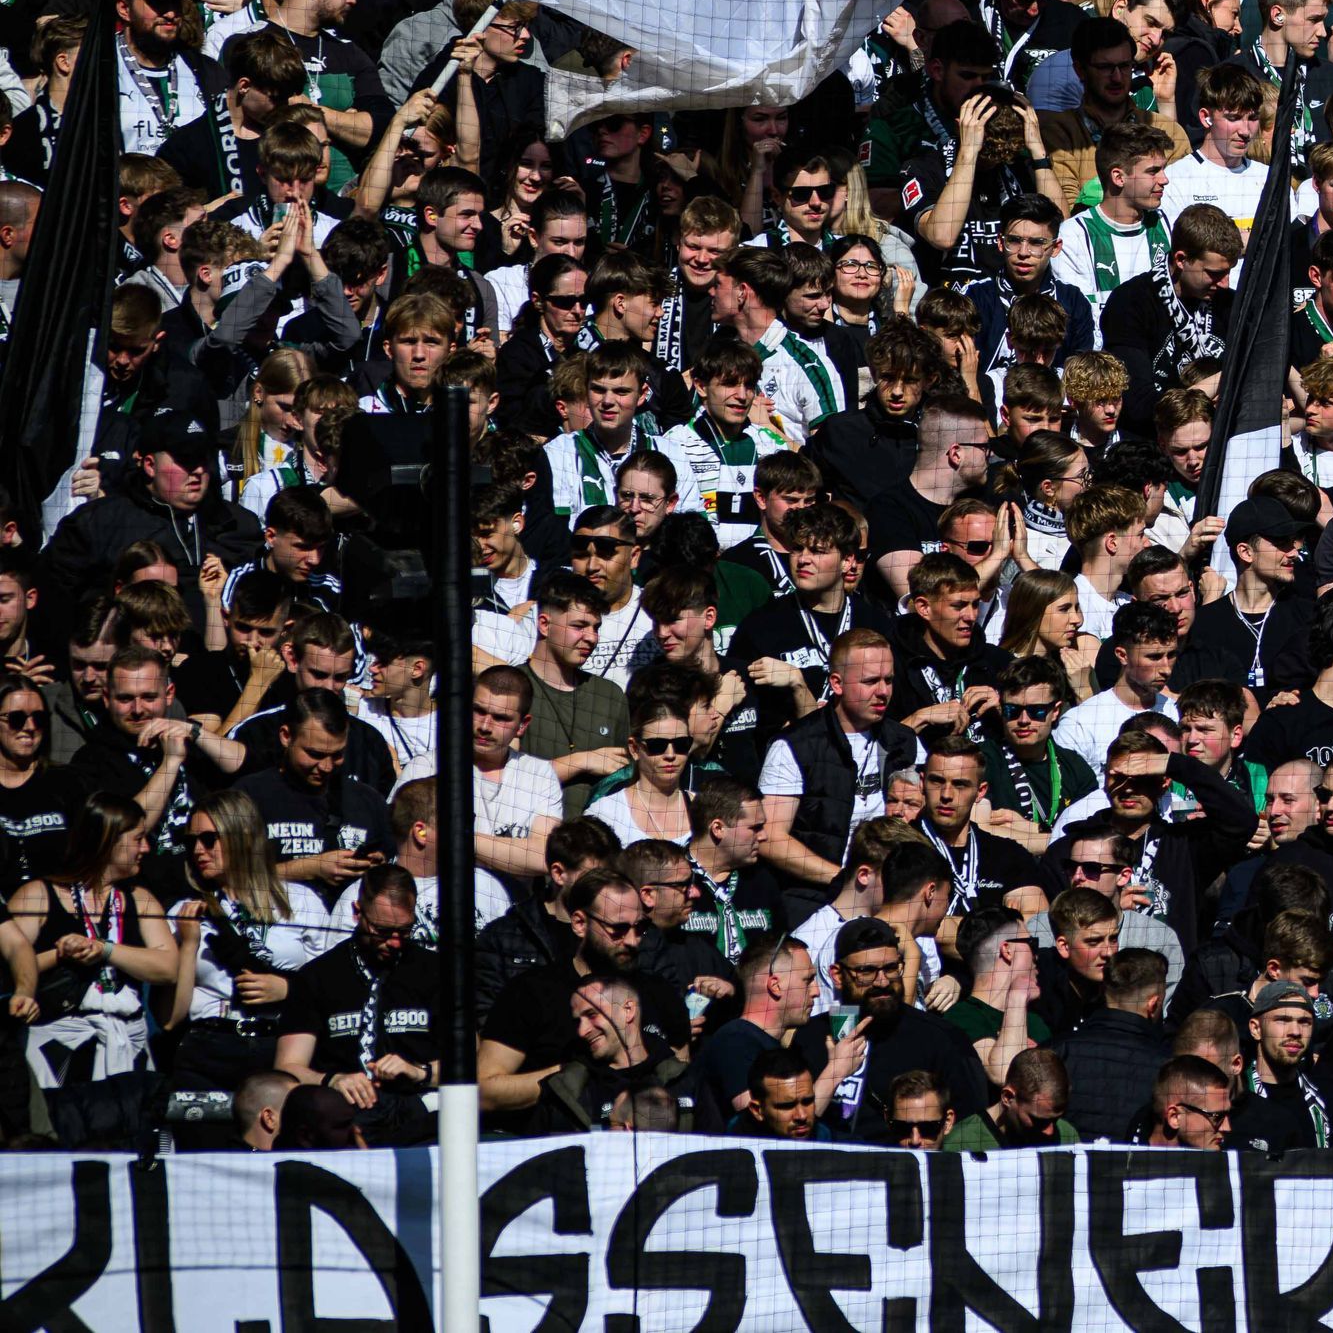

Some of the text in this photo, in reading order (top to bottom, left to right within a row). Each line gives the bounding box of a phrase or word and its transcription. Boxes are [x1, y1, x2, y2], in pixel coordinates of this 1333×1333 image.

[269, 824, 316, 838] NEUN
[281, 838, 325, 853] ZEHN
[329, 1011, 428, 1031] SEIT 1900
